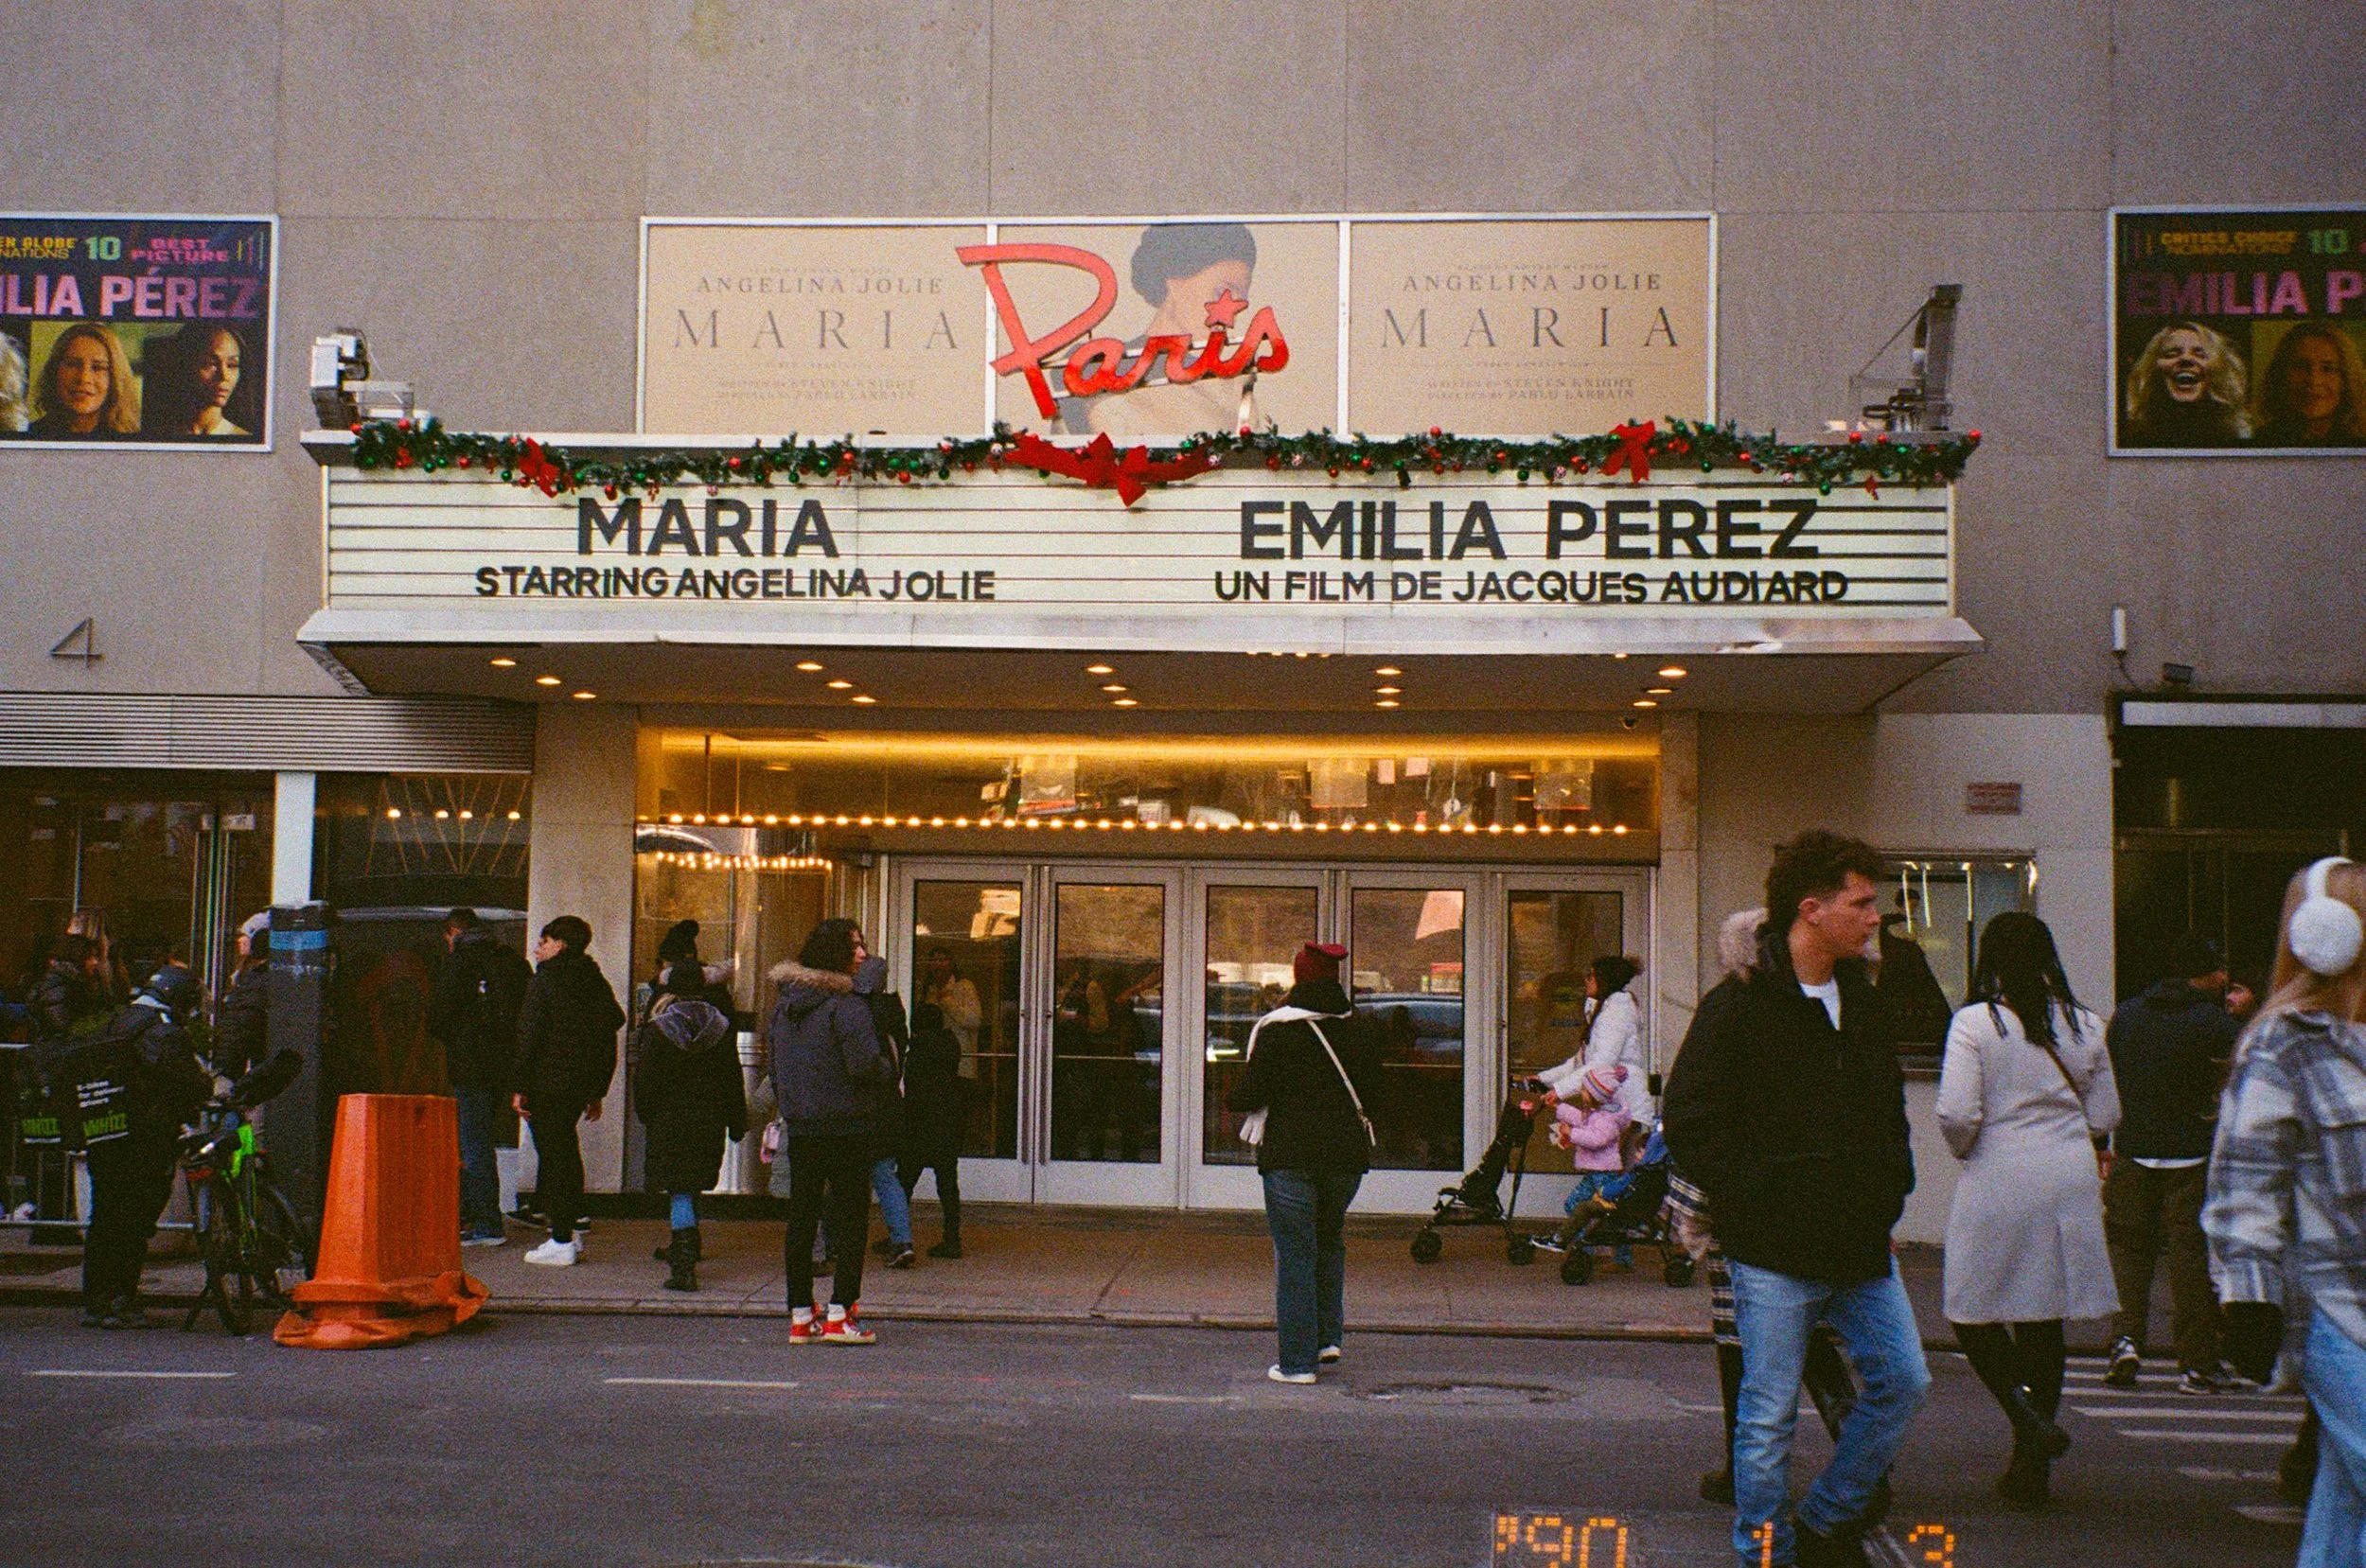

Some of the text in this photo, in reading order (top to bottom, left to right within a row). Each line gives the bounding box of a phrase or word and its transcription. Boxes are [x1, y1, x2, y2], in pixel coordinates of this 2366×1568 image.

[23, 237, 77, 250] GLOBE
[84, 237, 121, 260] 10
[131, 249, 229, 263] PICTURE
[150, 238, 211, 250] BEST
[2308, 229, 2349, 255] 10
[99, 266, 258, 318] PÉREZ
[697, 276, 944, 294] ANGELINA JOLIE
[1403, 273, 1661, 292] ANGELINA JOLIE
[2128, 270, 2366, 316] EMILIA P
[672, 308, 959, 349] MARIA
[955, 243, 1290, 419] Paris
[1379, 306, 1679, 347] MARIA
[578, 497, 840, 556] MARIA
[1241, 499, 1820, 560] EMILIA PEREZ
[475, 566, 995, 601] STARRING ANGELINA JOLIE
[1215, 570, 1848, 603] UN FILM DE JACQUES AUDIARD
[50, 616, 106, 668] 4
